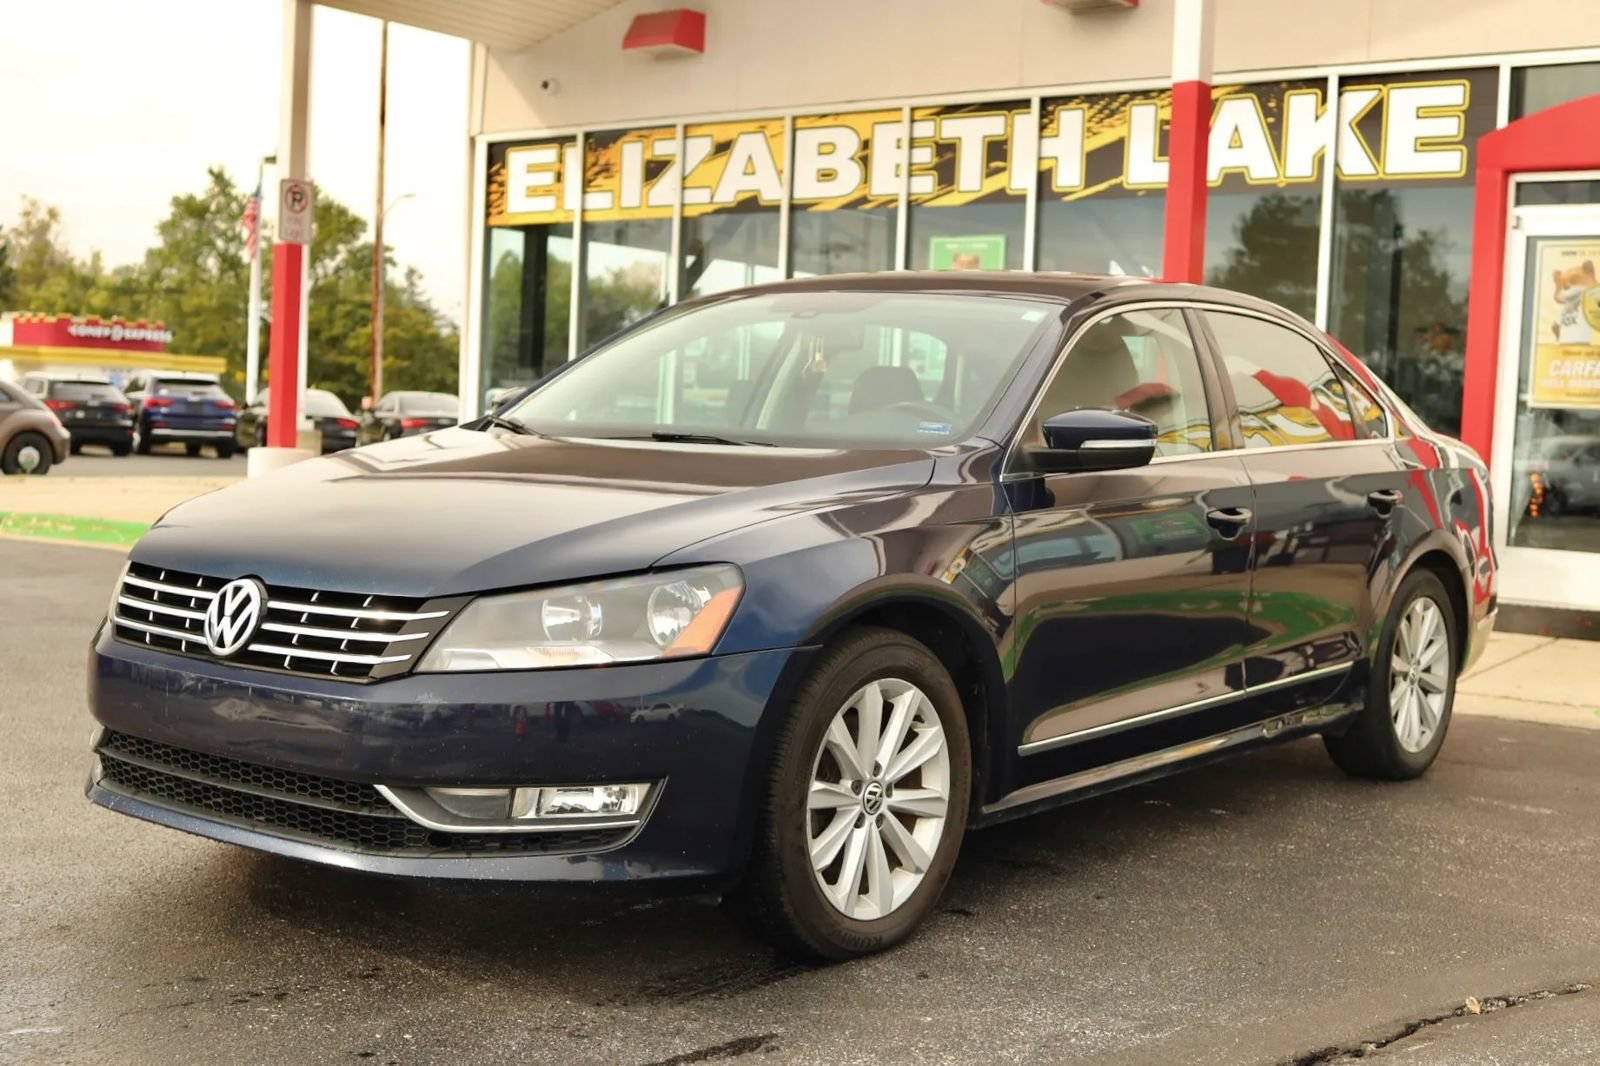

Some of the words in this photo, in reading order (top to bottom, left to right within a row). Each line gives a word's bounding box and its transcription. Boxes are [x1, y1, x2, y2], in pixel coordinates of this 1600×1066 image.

[507, 107, 1084, 214] ELIZABETH
[1126, 83, 1470, 188] LAKE
[205, 578, 261, 656] VW
